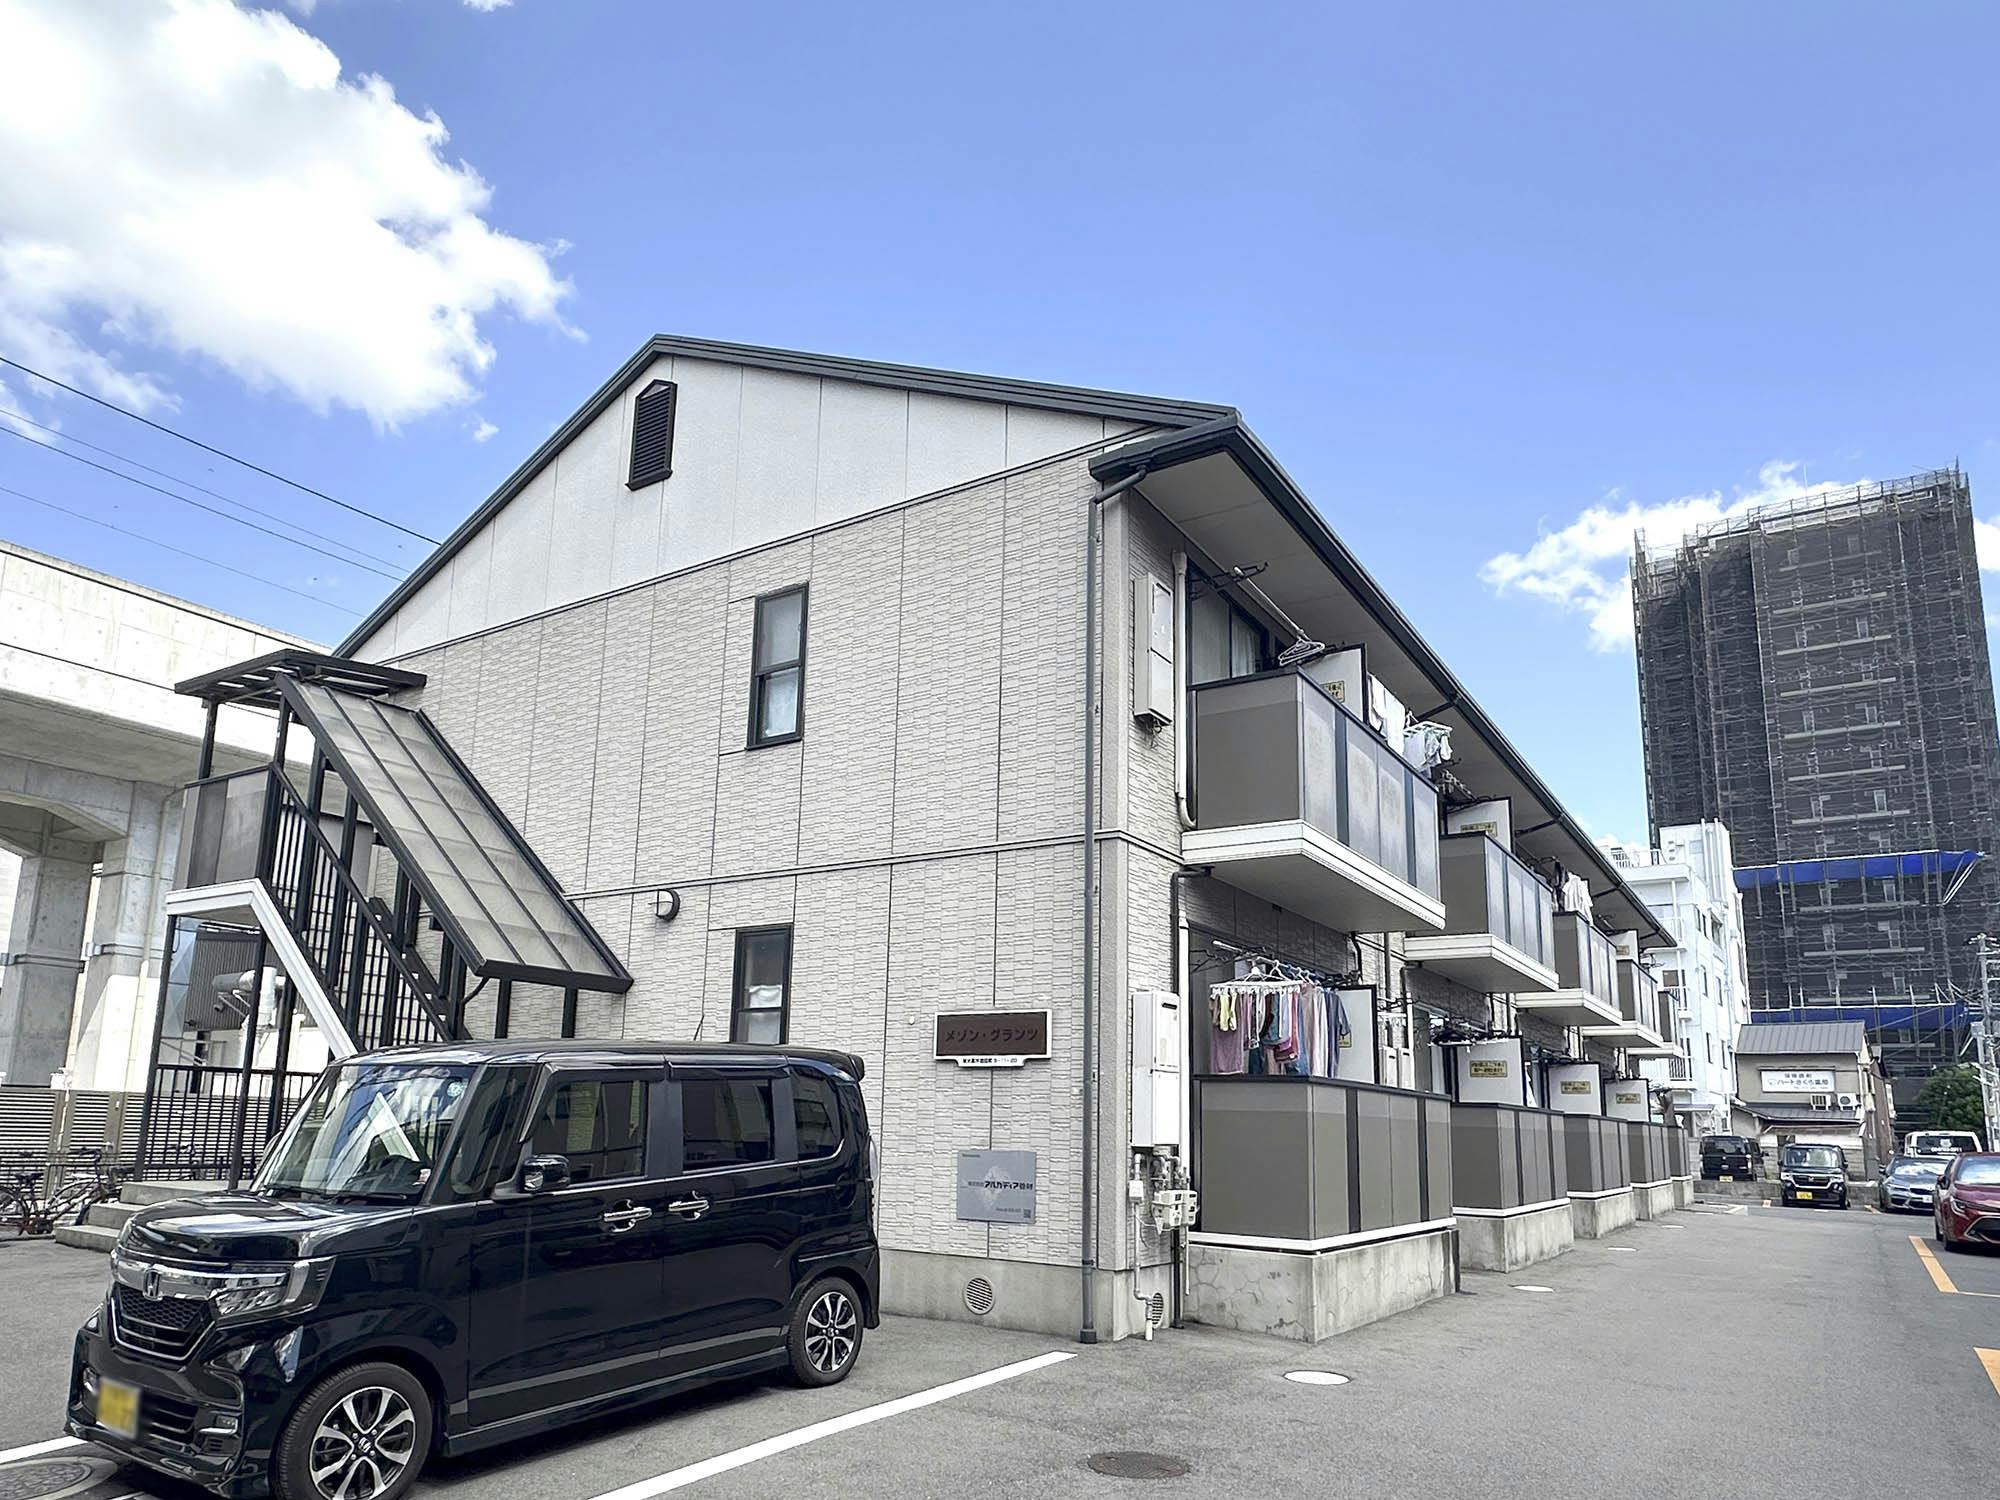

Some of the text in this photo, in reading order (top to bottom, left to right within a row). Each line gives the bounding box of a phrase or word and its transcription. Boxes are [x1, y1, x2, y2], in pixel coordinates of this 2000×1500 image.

[945, 1028, 1039, 1042] メゾン・グランツ
